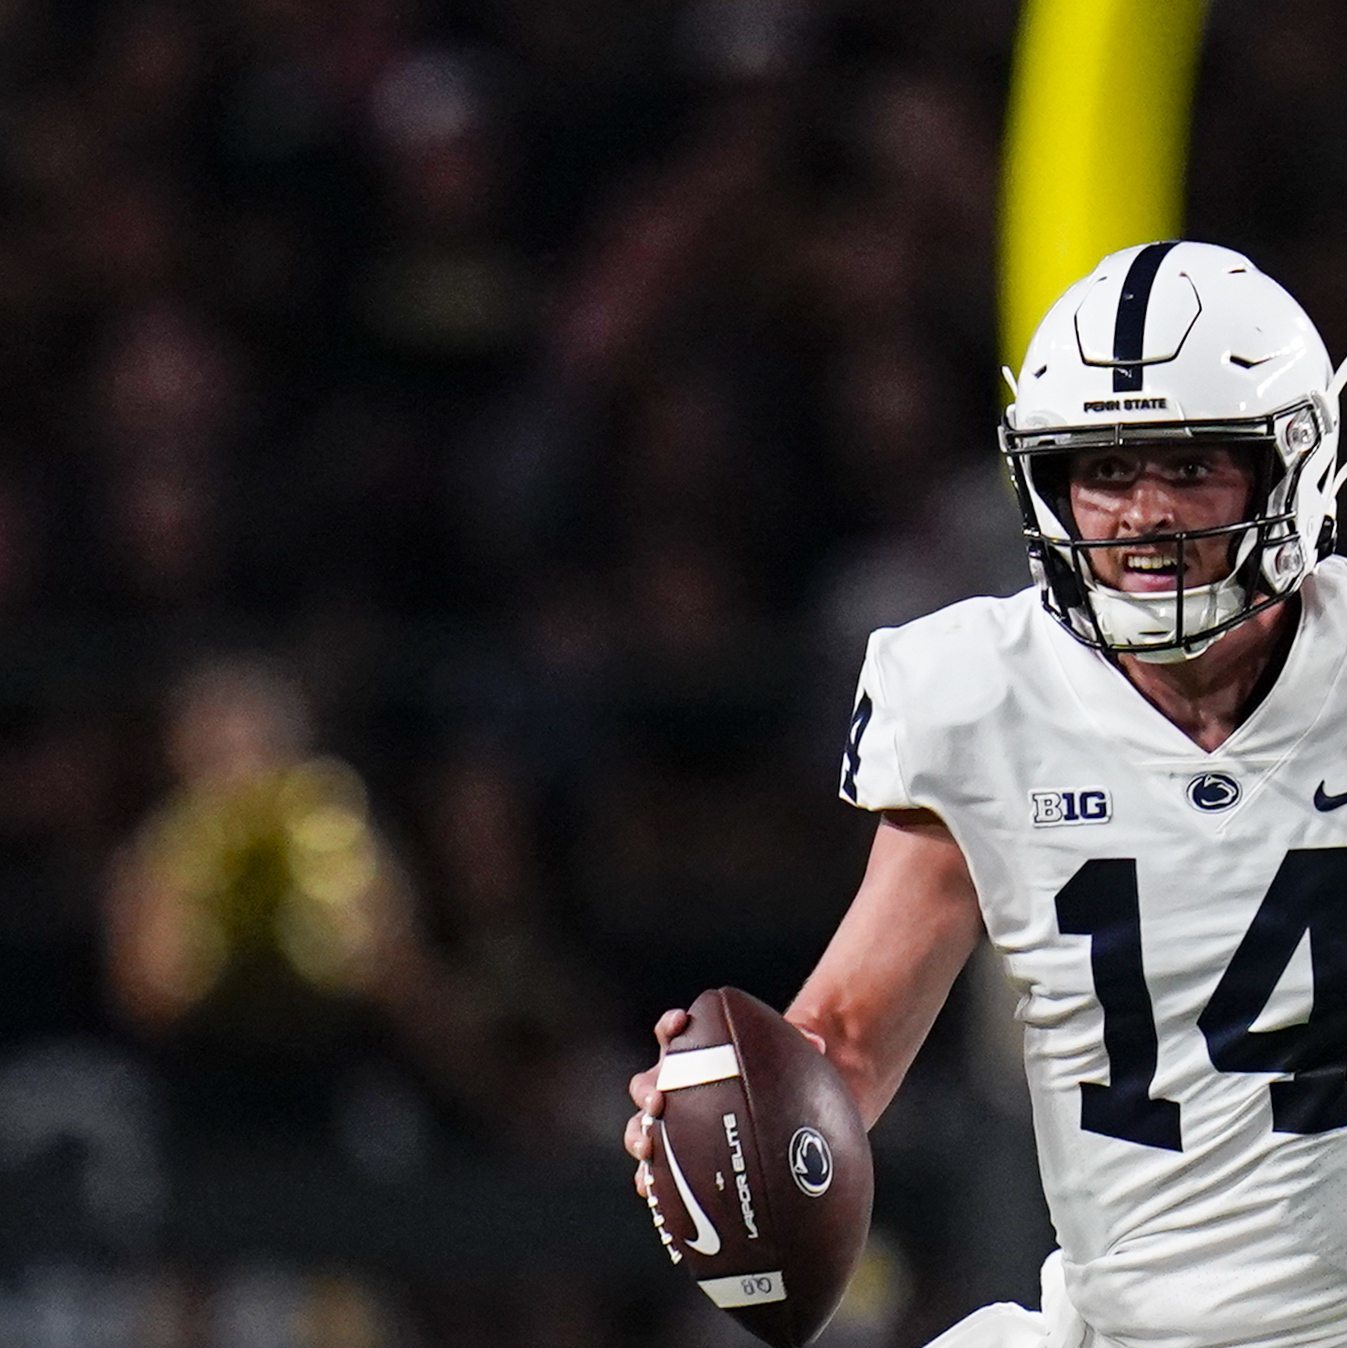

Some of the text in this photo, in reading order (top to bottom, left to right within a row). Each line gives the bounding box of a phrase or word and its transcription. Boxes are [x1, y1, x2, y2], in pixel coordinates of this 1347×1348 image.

[1084, 398, 1167, 413] PENN STATE
[722, 1112, 760, 1239] VAPOR ELITE
